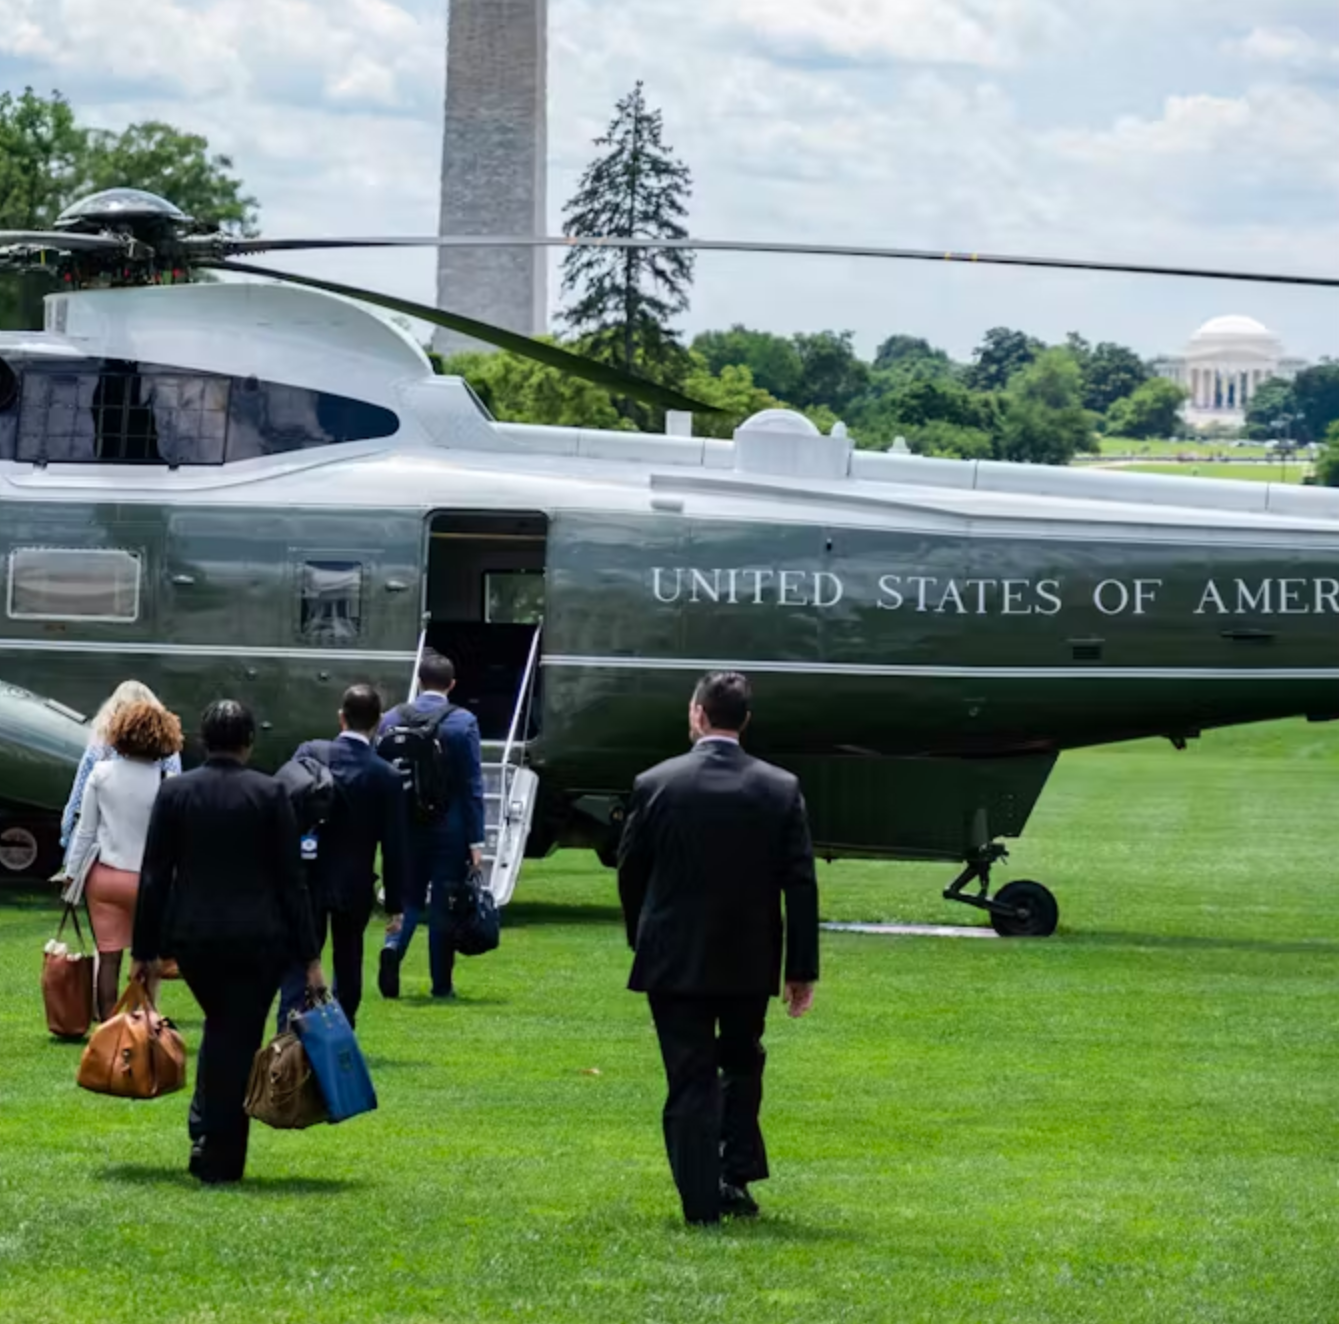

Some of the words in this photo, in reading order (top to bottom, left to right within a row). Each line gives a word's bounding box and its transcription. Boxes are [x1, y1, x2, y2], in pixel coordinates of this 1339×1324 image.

[651, 567, 843, 607] UNITED
[876, 574, 1062, 615] STATES
[1093, 578, 1162, 615] OF
[1193, 578, 1339, 614] AMER
